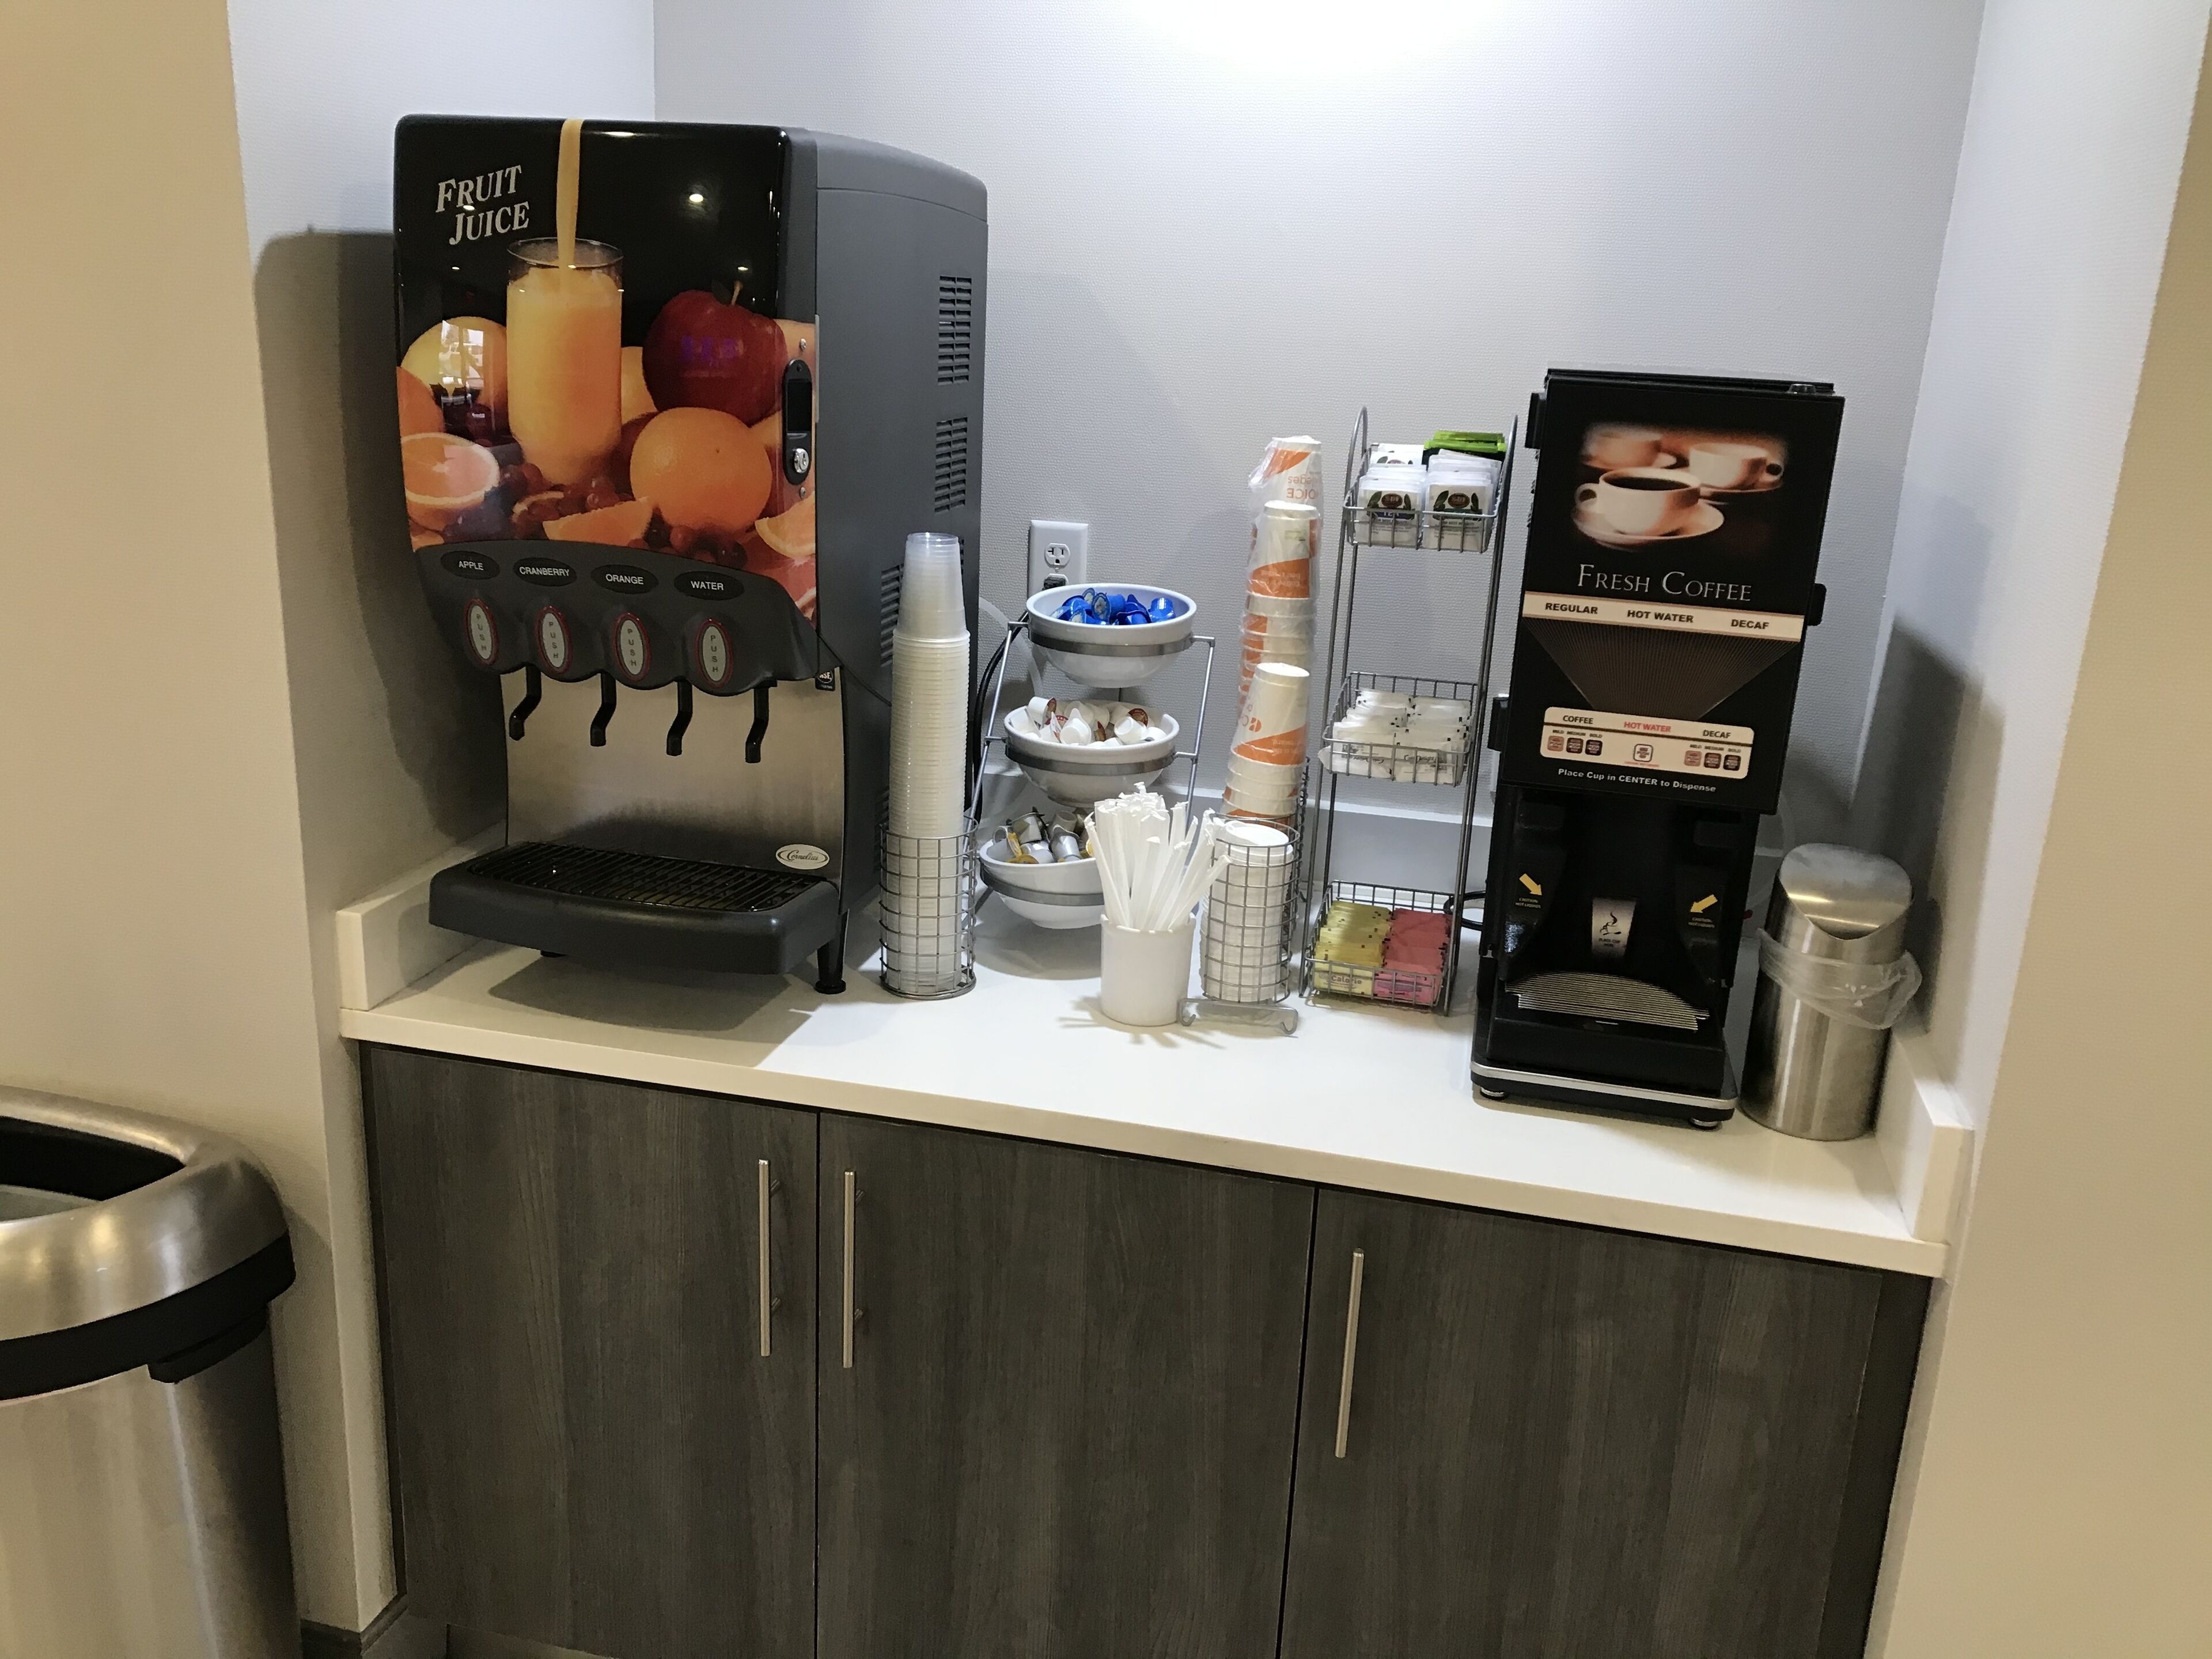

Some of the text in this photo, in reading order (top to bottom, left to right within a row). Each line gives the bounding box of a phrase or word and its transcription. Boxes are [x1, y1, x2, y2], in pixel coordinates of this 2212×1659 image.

[435, 165, 523, 213] FRUIT
[449, 202, 530, 245] JUICE
[459, 560, 484, 571] APPLE
[519, 566, 570, 577] CRANBERRY
[605, 574, 644, 585] ORANGE
[691, 581, 724, 591] WATER
[1577, 564, 1752, 601] FRESH COFFEE
[1544, 602, 1599, 615] REGULAR
[1627, 609, 1694, 623] HOT WATER
[1730, 619, 1770, 630] DECAF
[476, 613, 487, 652] PUSH
[548, 621, 559, 660] PUSH
[627, 628, 637, 667] PUSH
[710, 634, 719, 673] PUSH
[1563, 715, 1594, 725] COFFEE
[1624, 721, 1672, 732] HOT WATER
[1702, 729, 1731, 738] DECAF
[1558, 768, 1584, 778] Place
[1586, 772, 1605, 781] Cup
[1619, 775, 1658, 786] CENTER
[1673, 781, 1717, 791] Dispense
[787, 850, 819, 861] Cornelius
